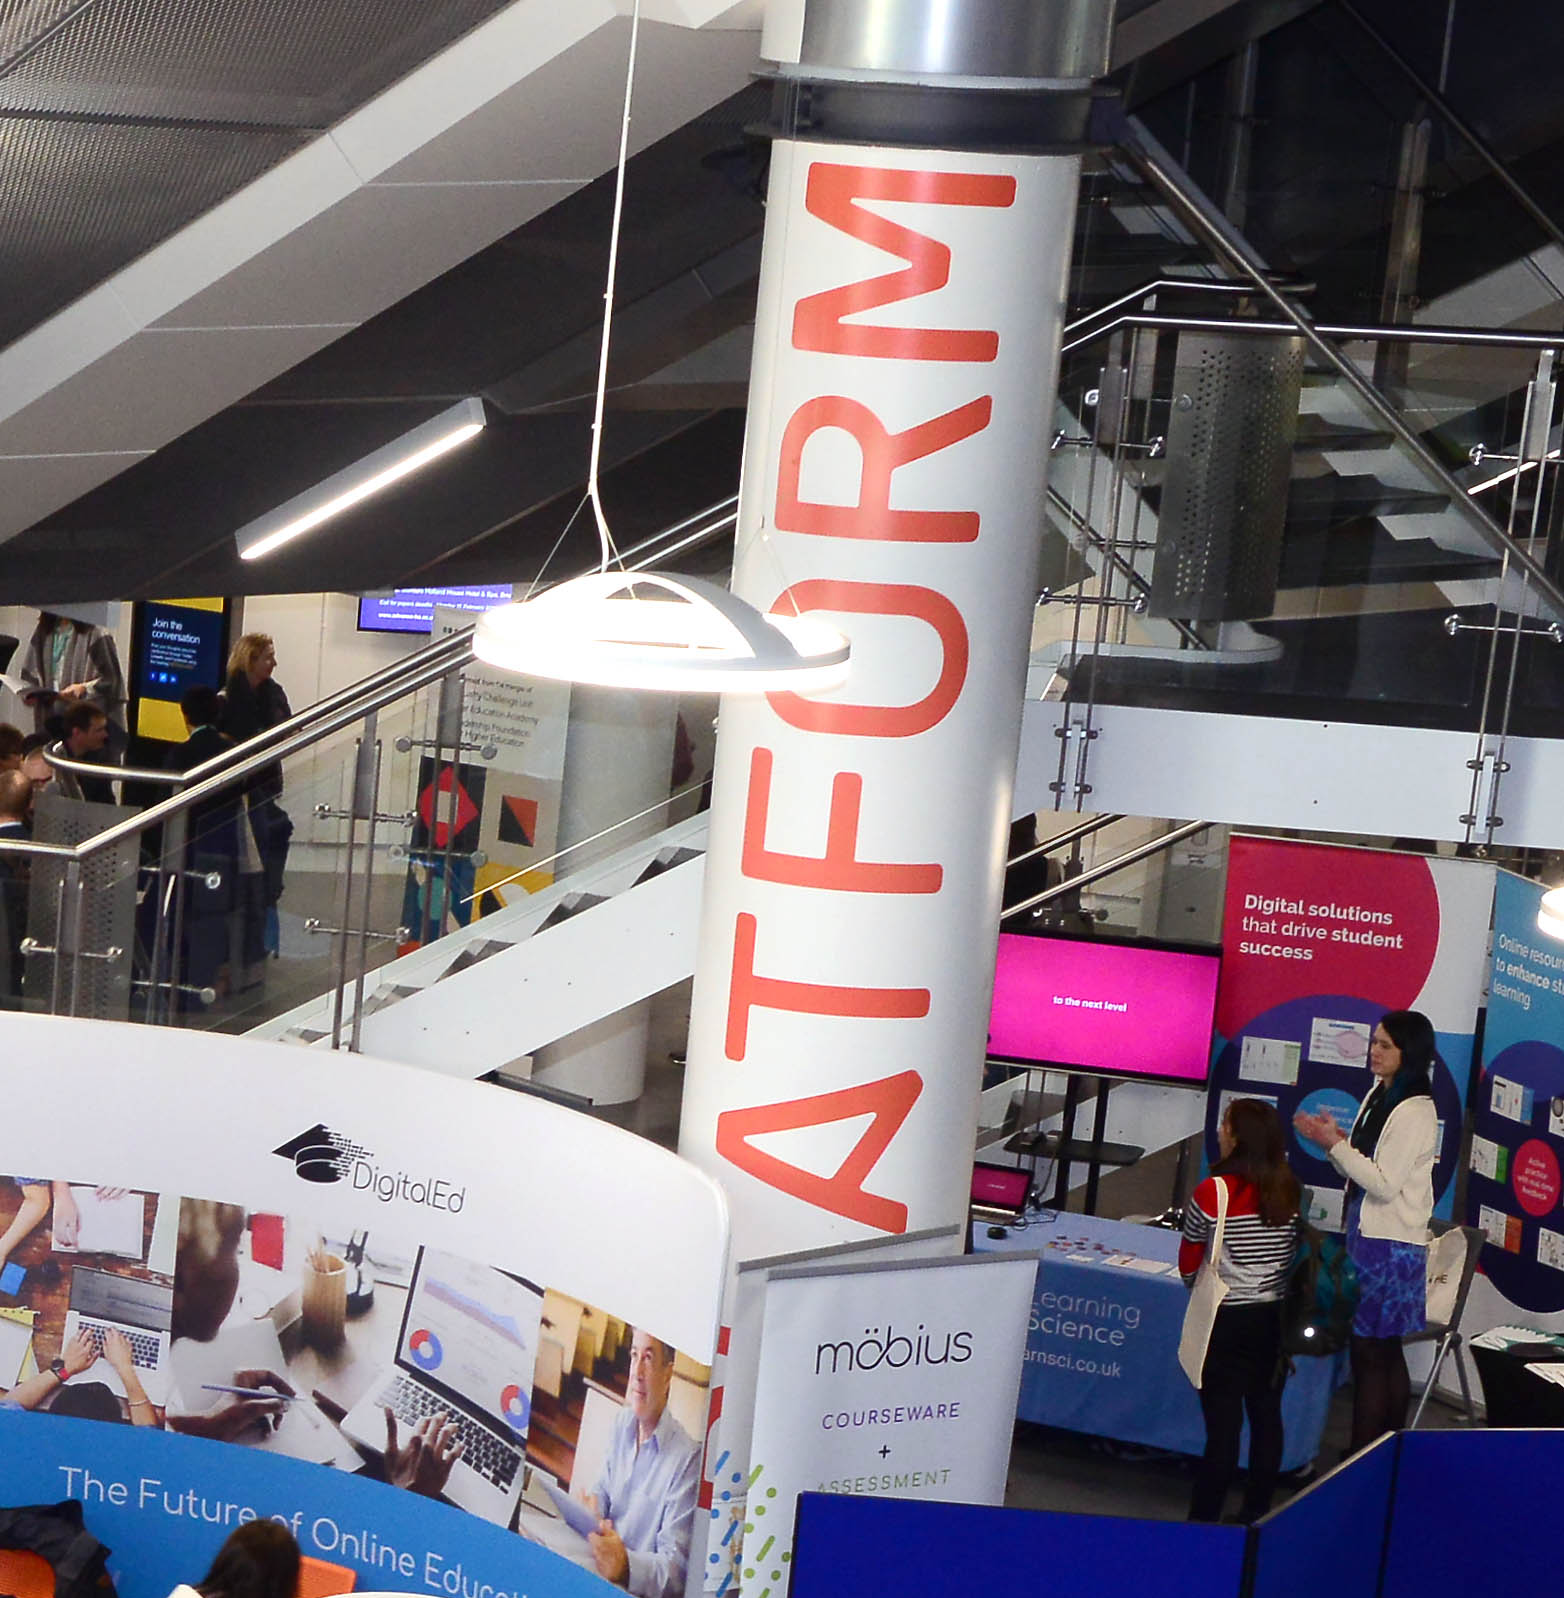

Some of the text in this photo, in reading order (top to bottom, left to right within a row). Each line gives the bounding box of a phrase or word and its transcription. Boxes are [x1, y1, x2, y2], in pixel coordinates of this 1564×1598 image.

[151, 630, 201, 644] conversation
[152, 617, 183, 631] Join the
[716, 160, 1017, 1237] ATFORM
[1244, 894, 1393, 925] Digital solutions
[1242, 916, 1404, 949] that drive student
[1239, 941, 1314, 960] success
[1499, 933, 1564, 972] Online resour
[1496, 957, 1506, 972] to
[1506, 964, 1551, 989] enhance
[1052, 995, 1128, 1013] to the next level
[1493, 977, 1531, 1010] learning
[352, 1160, 466, 1214] DigitalEd
[1031, 1291, 1141, 1329] earning
[815, 1324, 973, 1375] möbius
[1024, 1349, 1121, 1378] arnsci.co.uk
[822, 1402, 961, 1430] COURSEWARE
[58, 1466, 128, 1506] The
[138, 1478, 258, 1528] Future
[312, 1518, 417, 1578] Online
